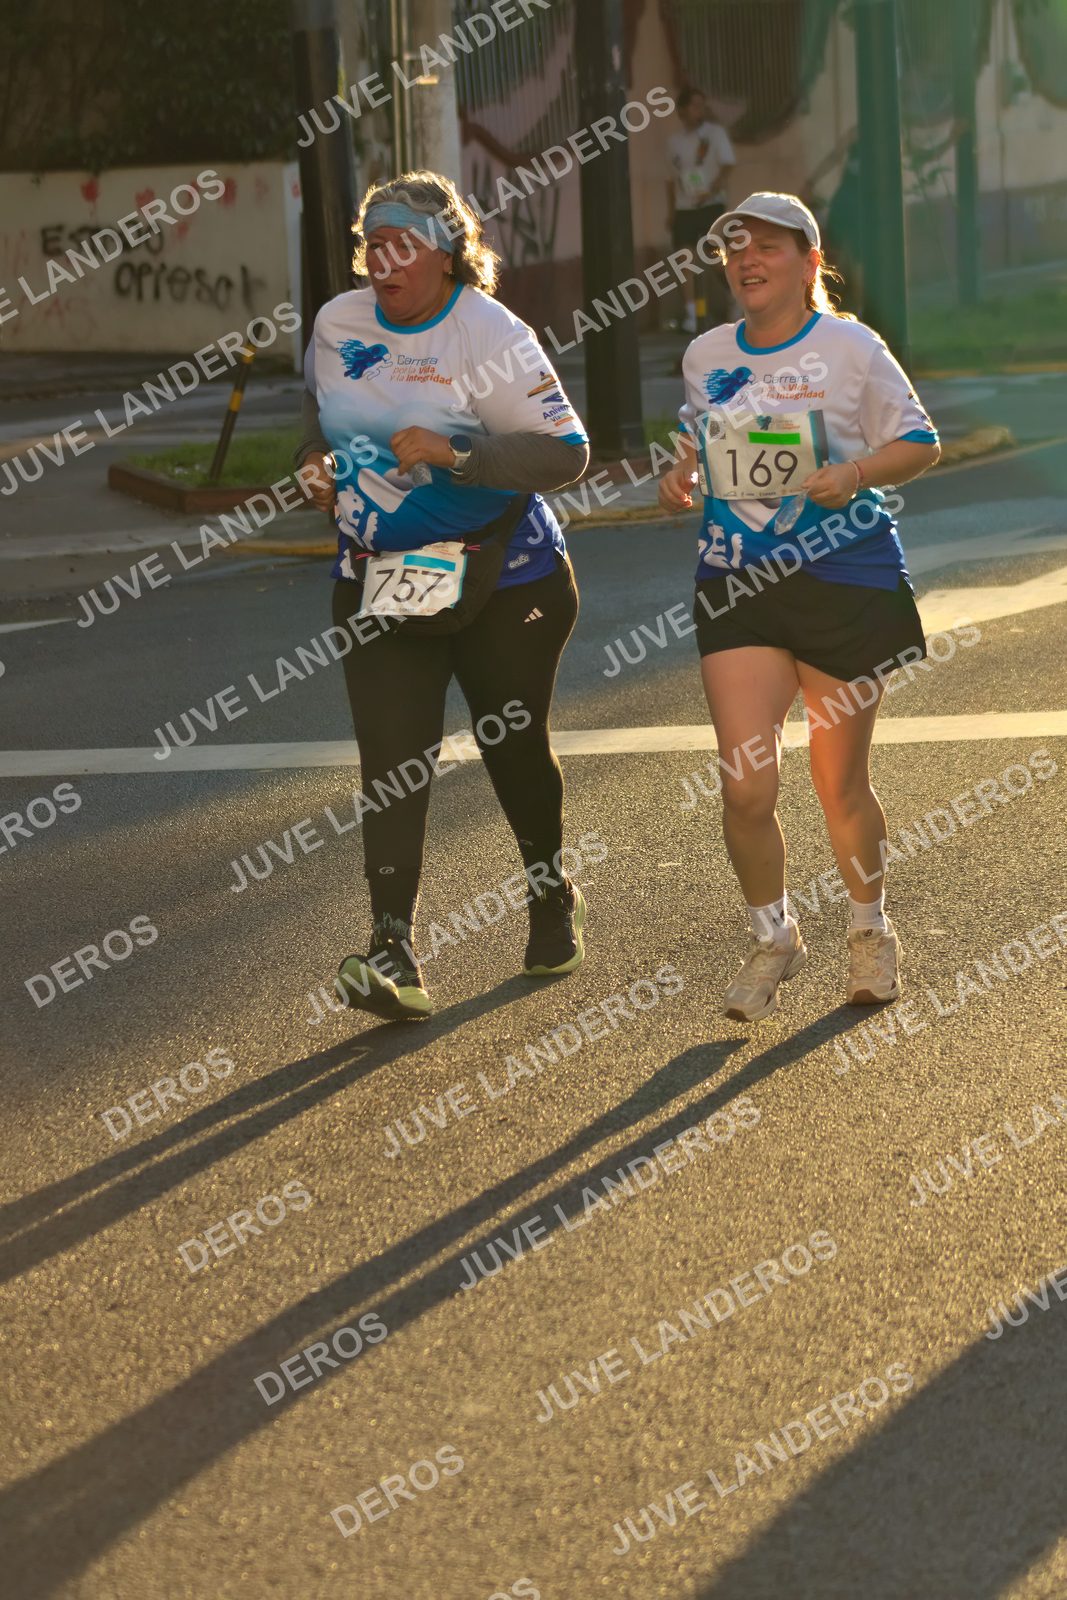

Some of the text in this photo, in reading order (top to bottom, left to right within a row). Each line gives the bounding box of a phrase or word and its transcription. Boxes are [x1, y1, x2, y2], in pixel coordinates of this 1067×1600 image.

[397, 354, 438, 366] Carrera
[763, 374, 809, 384] Carrera
[726, 449, 798, 487] 169
[371, 568, 447, 603] 757
